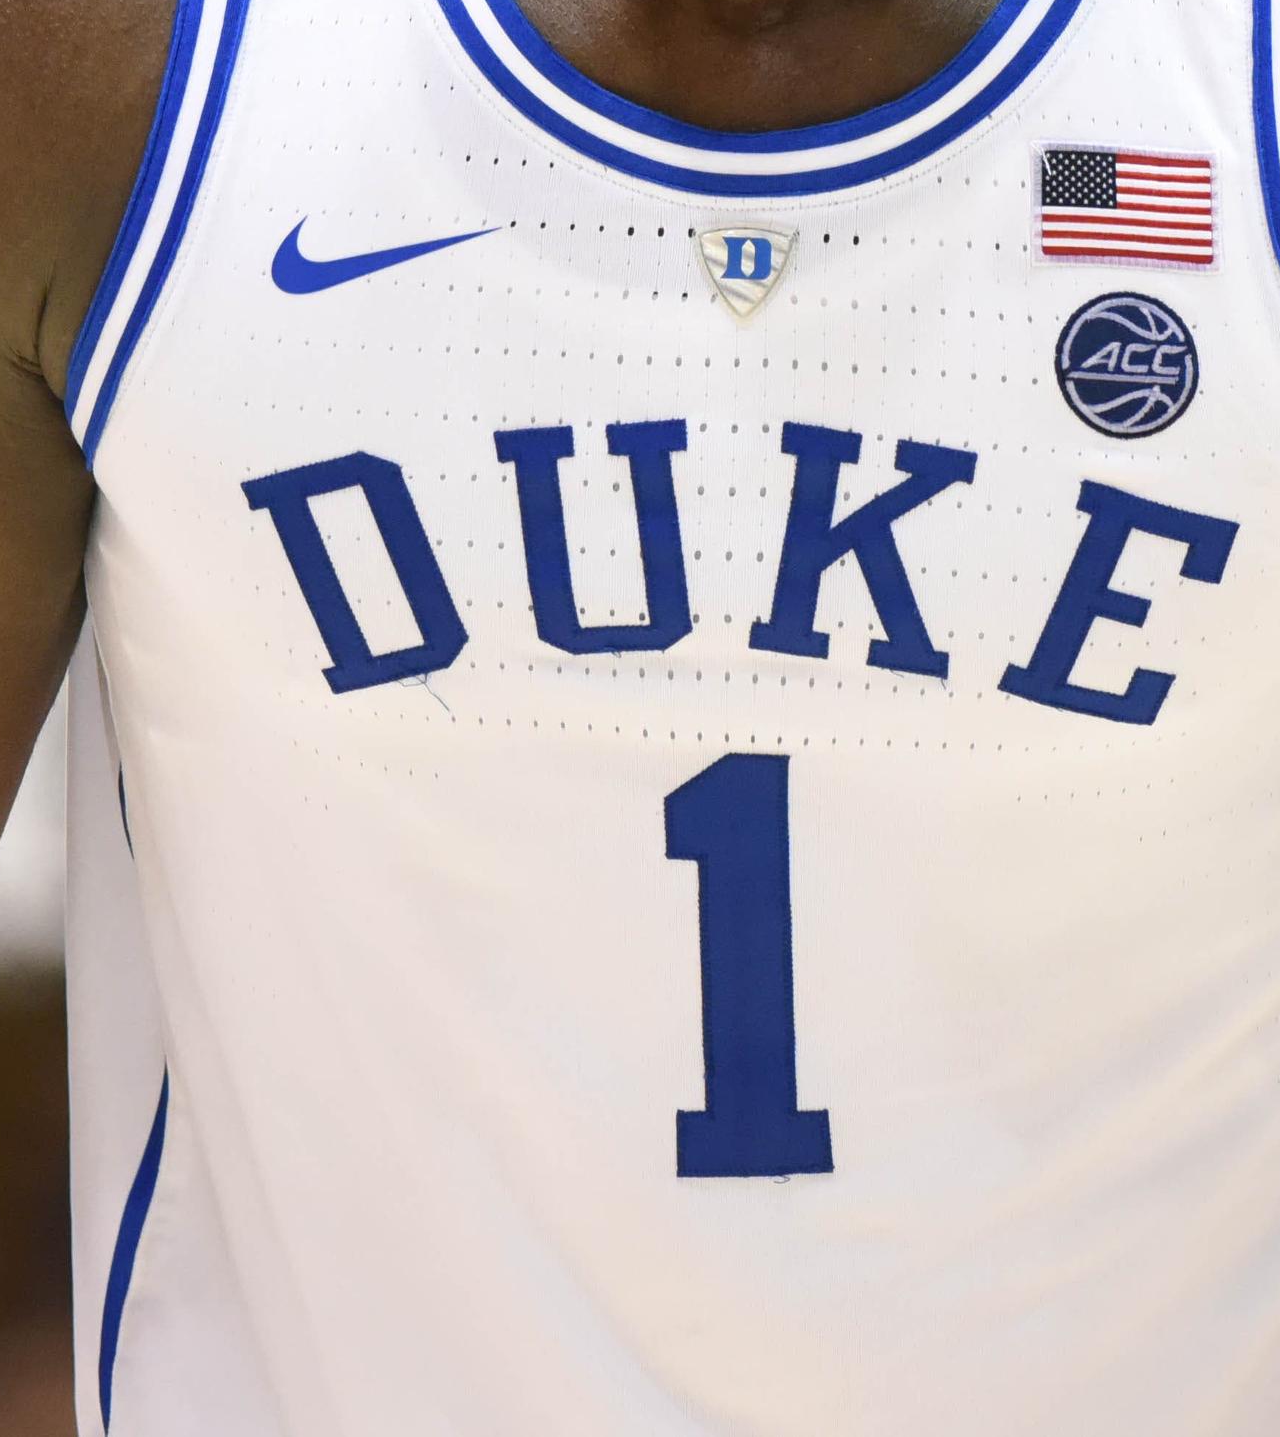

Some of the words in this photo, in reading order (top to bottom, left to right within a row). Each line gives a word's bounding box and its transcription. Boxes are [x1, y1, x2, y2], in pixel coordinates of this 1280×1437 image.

[720, 236, 772, 280] D
[1080, 341, 1188, 375] ACC
[241, 418, 1239, 726] DUKE
[663, 752, 834, 1178] 1
